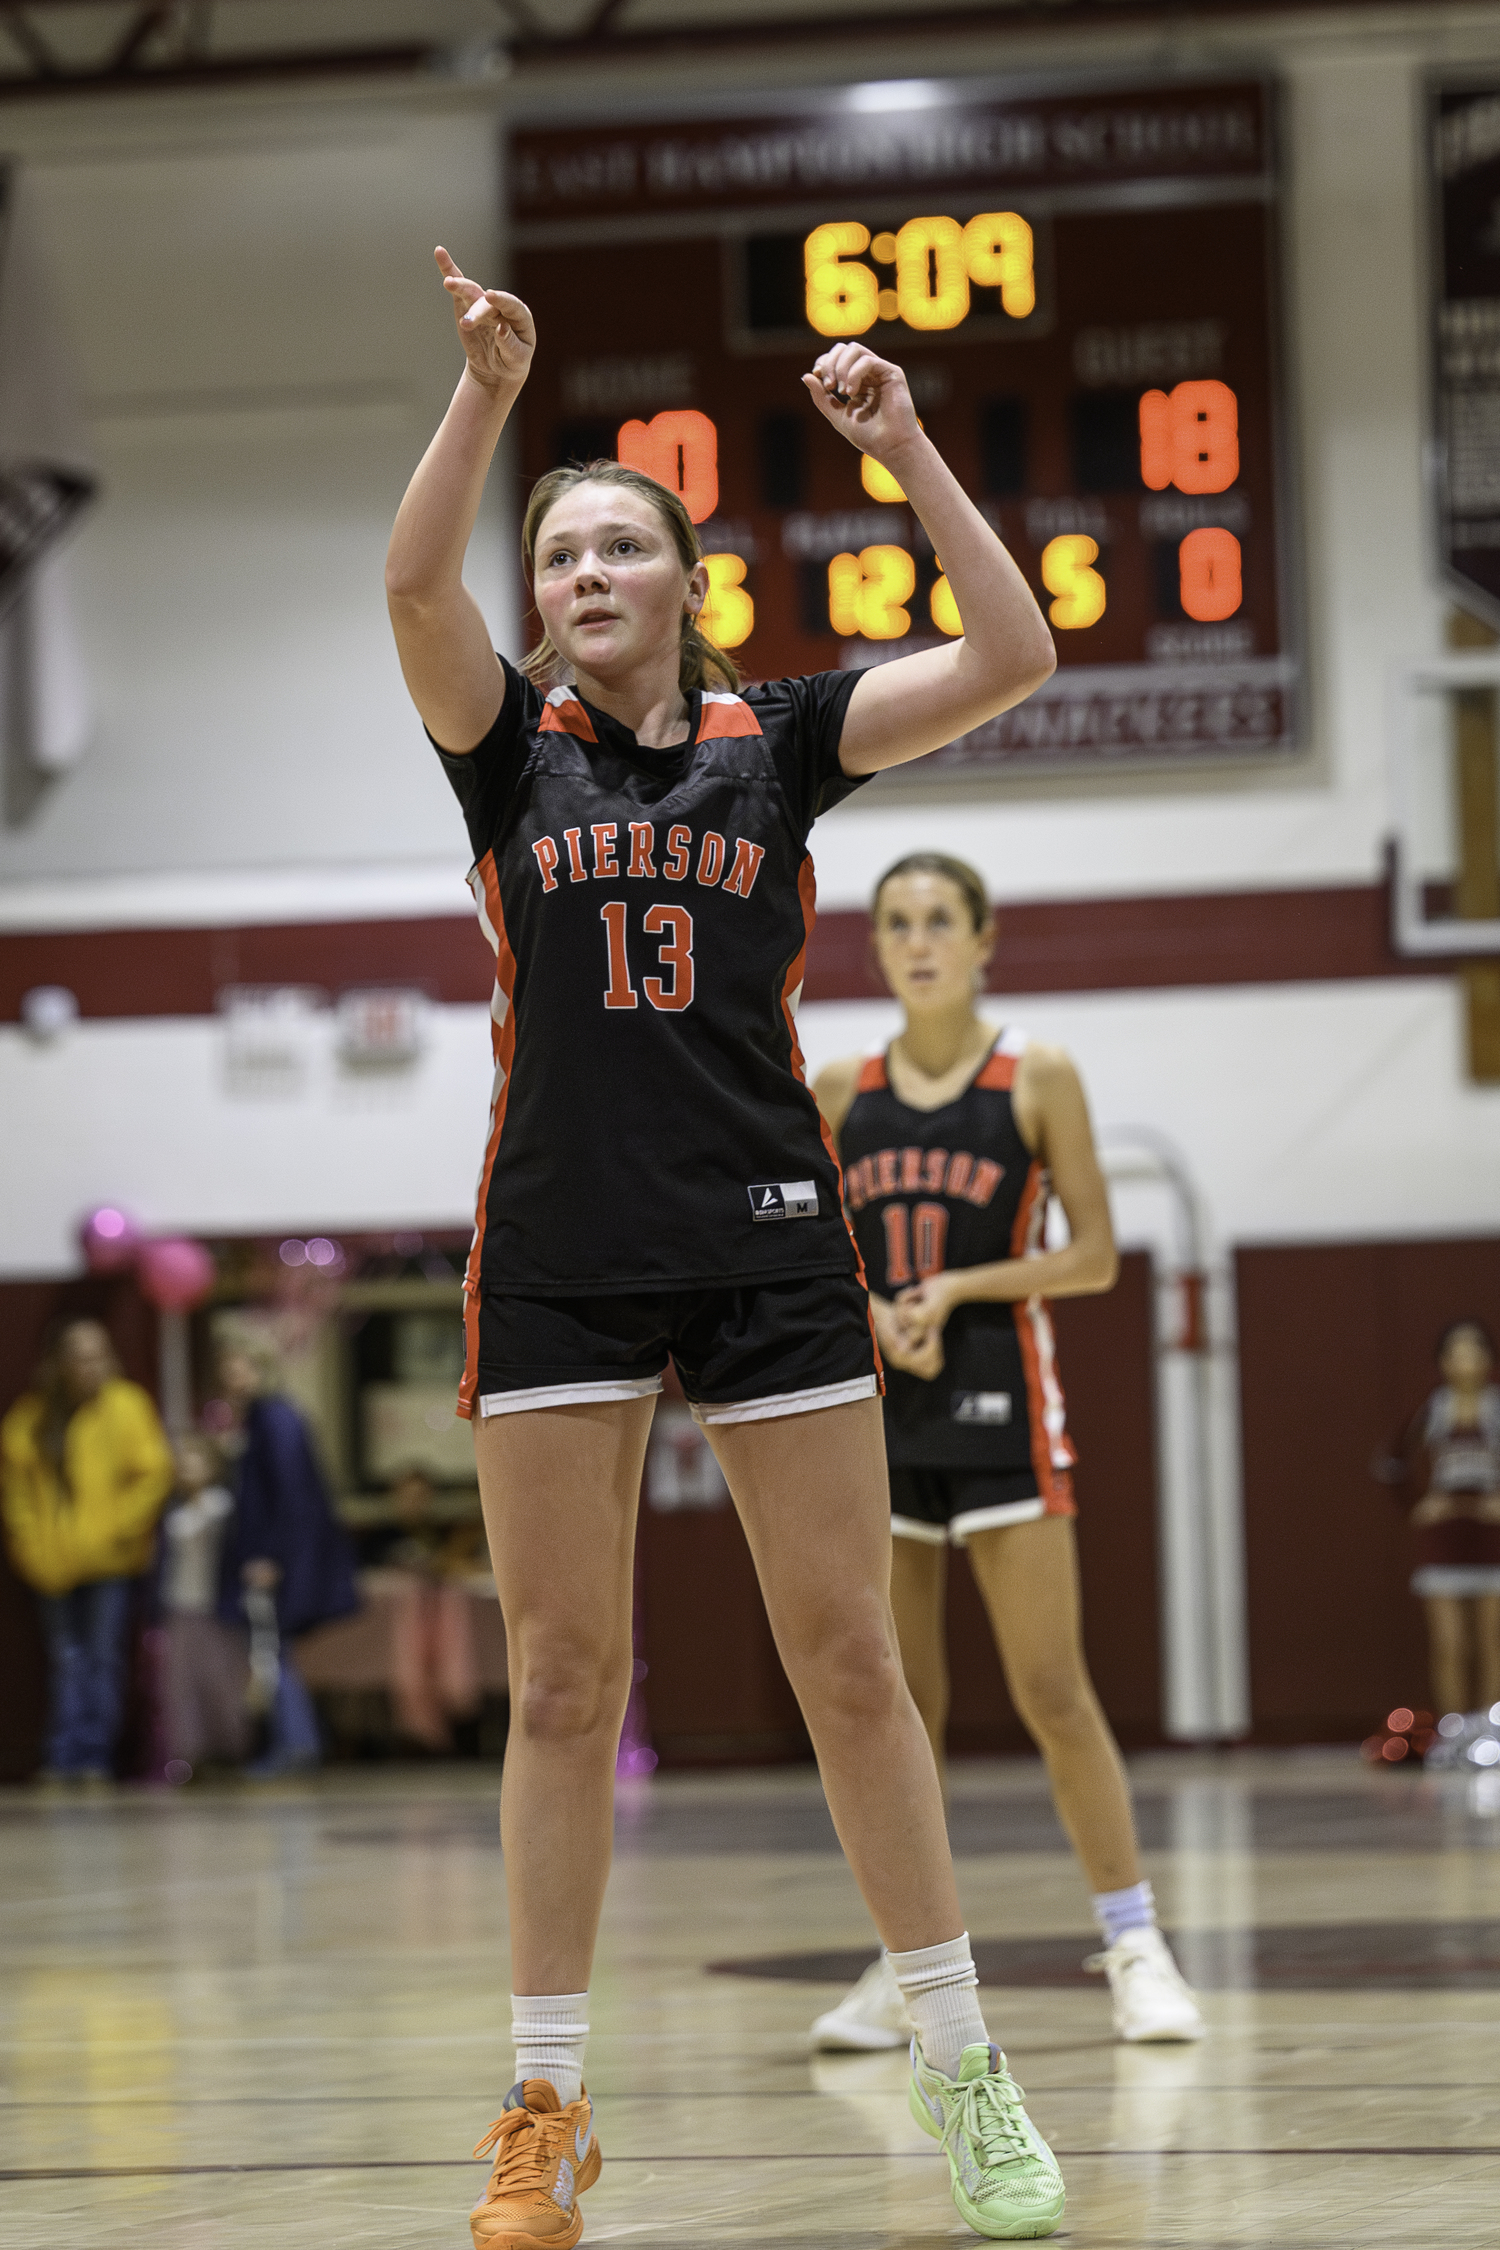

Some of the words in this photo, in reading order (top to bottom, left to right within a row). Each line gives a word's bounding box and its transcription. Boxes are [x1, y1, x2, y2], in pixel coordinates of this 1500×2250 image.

[805, 212, 1035, 336] 6:09
[1139, 380, 1239, 494] 18
[1042, 534, 1106, 629] 5
[1179, 527, 1242, 621] 0
[532, 821, 765, 898] PIERSON
[600, 902, 695, 1011] 13
[797, 1202, 808, 1213] M
[846, 1147, 1005, 1211] PIERSON
[881, 1202, 949, 1287] 10
